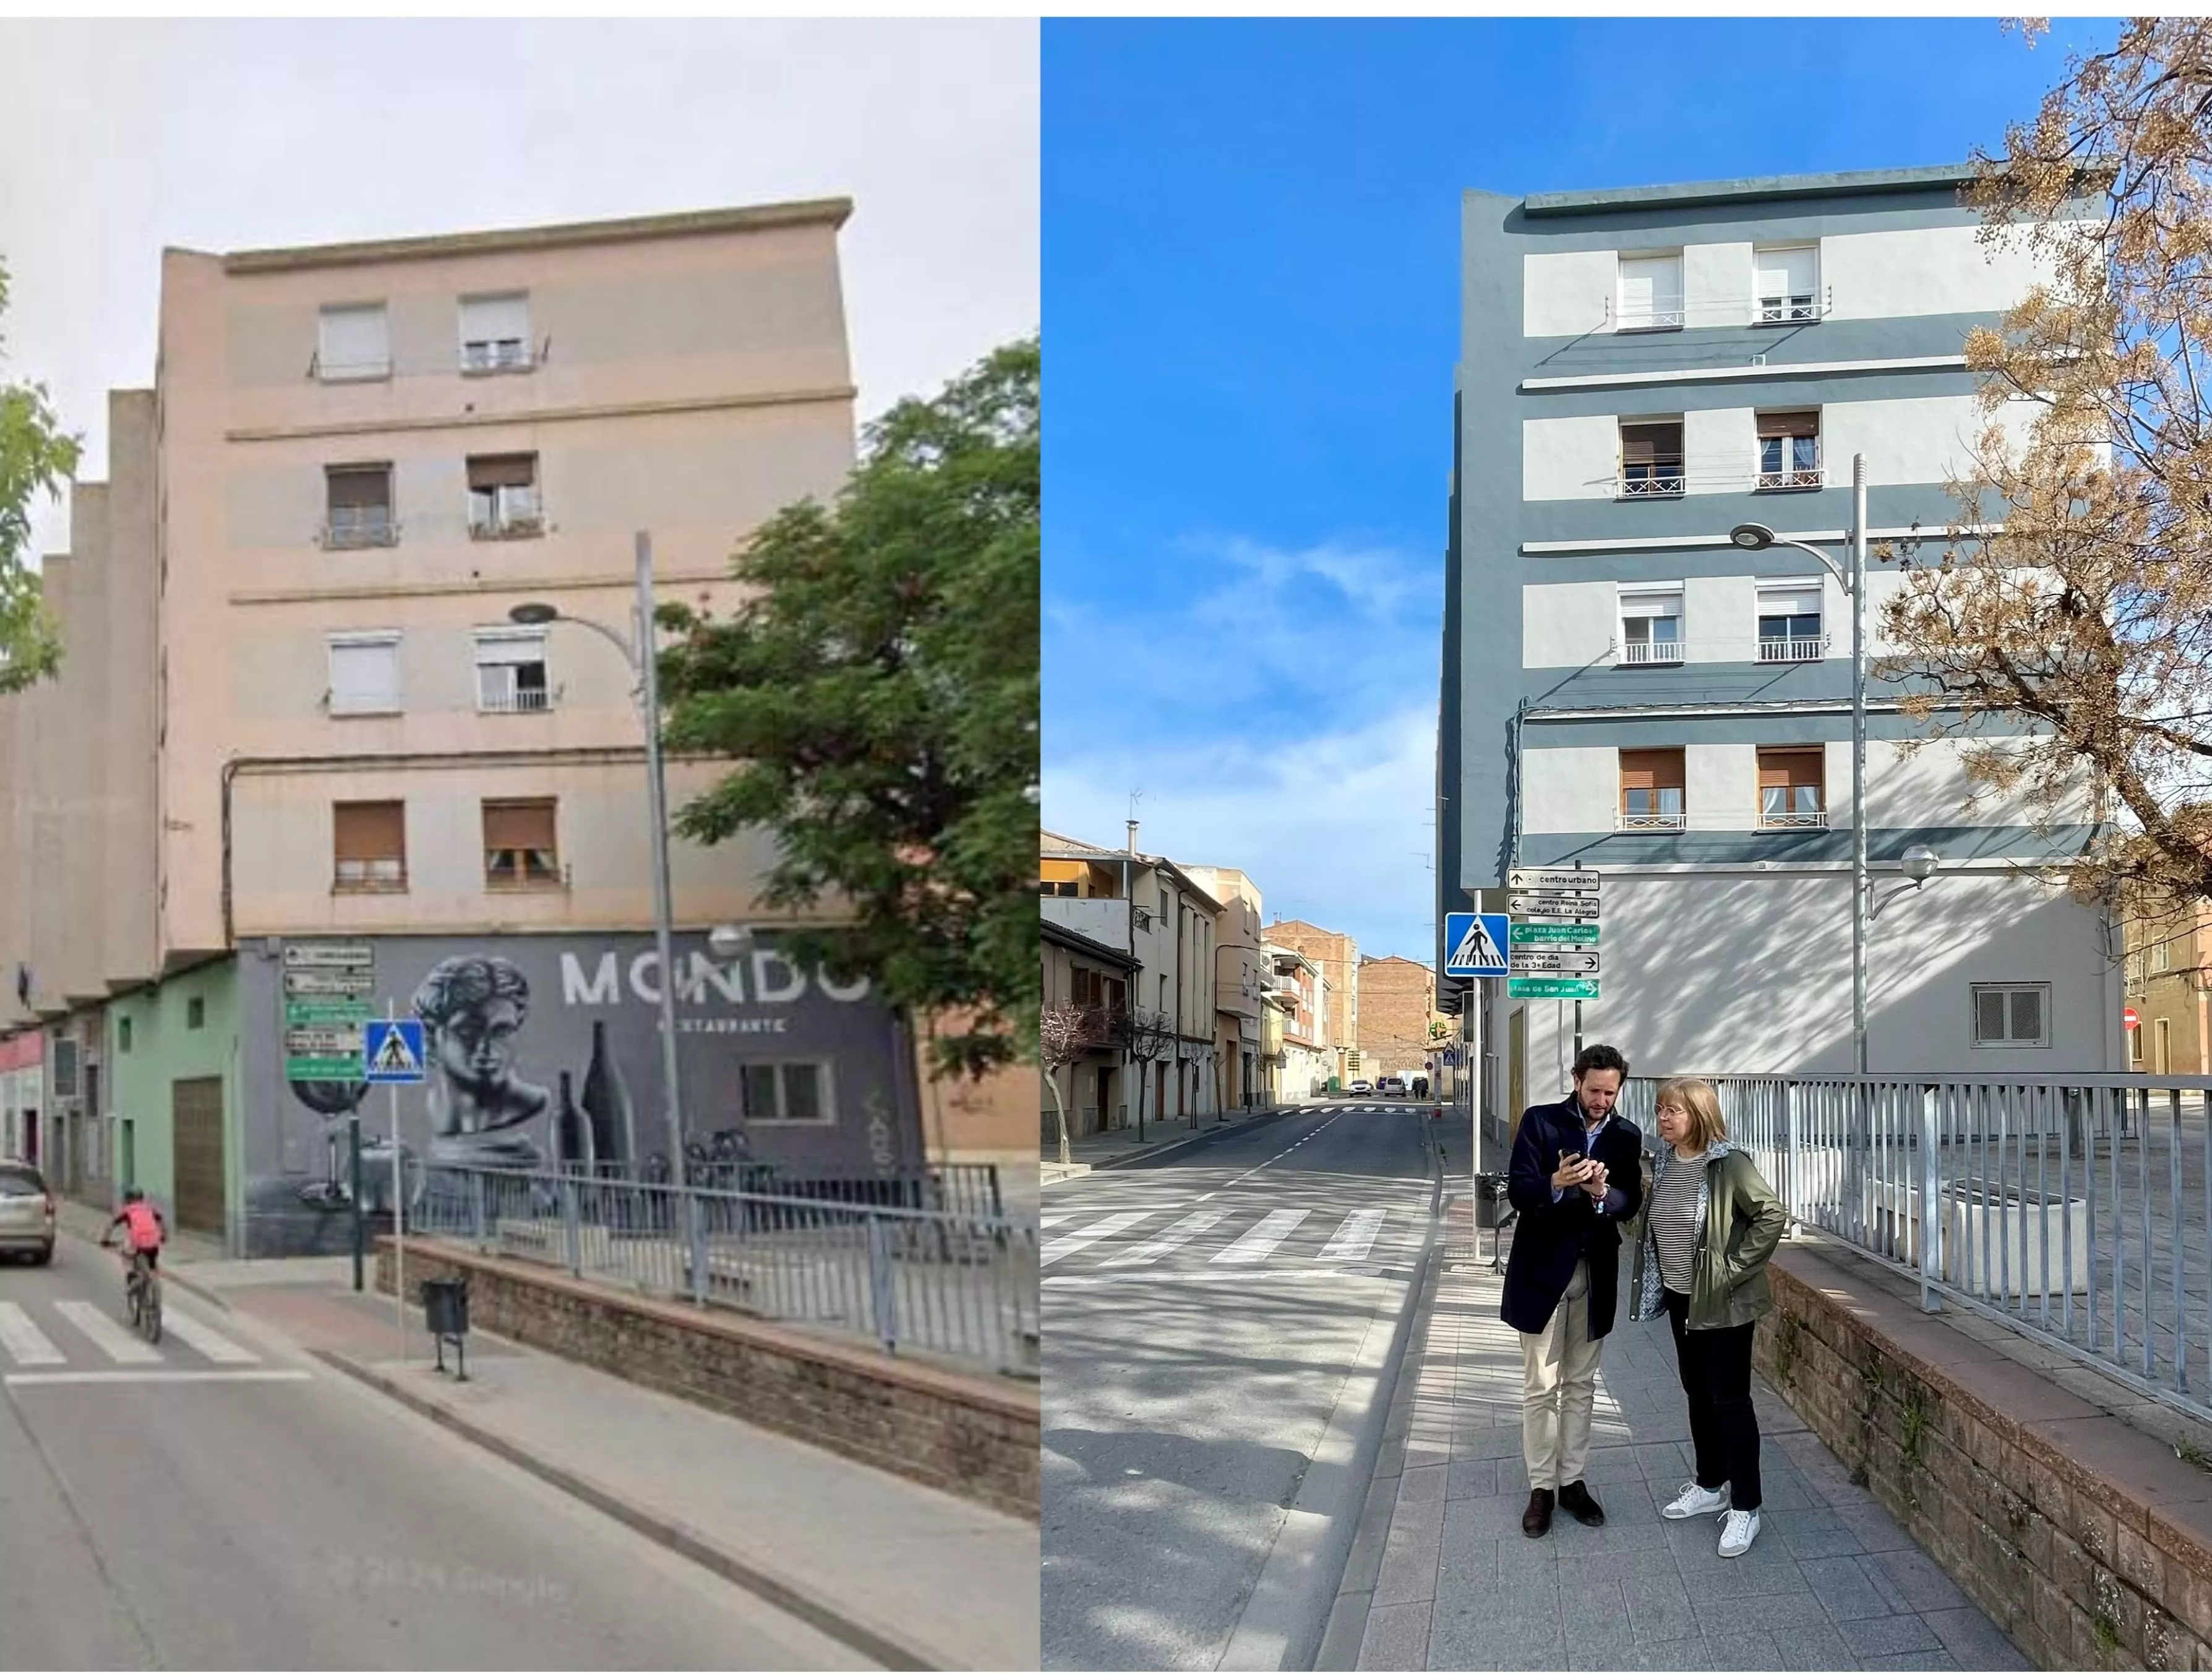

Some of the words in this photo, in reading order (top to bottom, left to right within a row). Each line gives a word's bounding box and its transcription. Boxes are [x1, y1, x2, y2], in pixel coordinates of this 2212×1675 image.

[1568, 876, 1597, 884] urbano
[560, 950, 870, 1006] MONDO
[658, 1018, 786, 1034] STAURANTE
